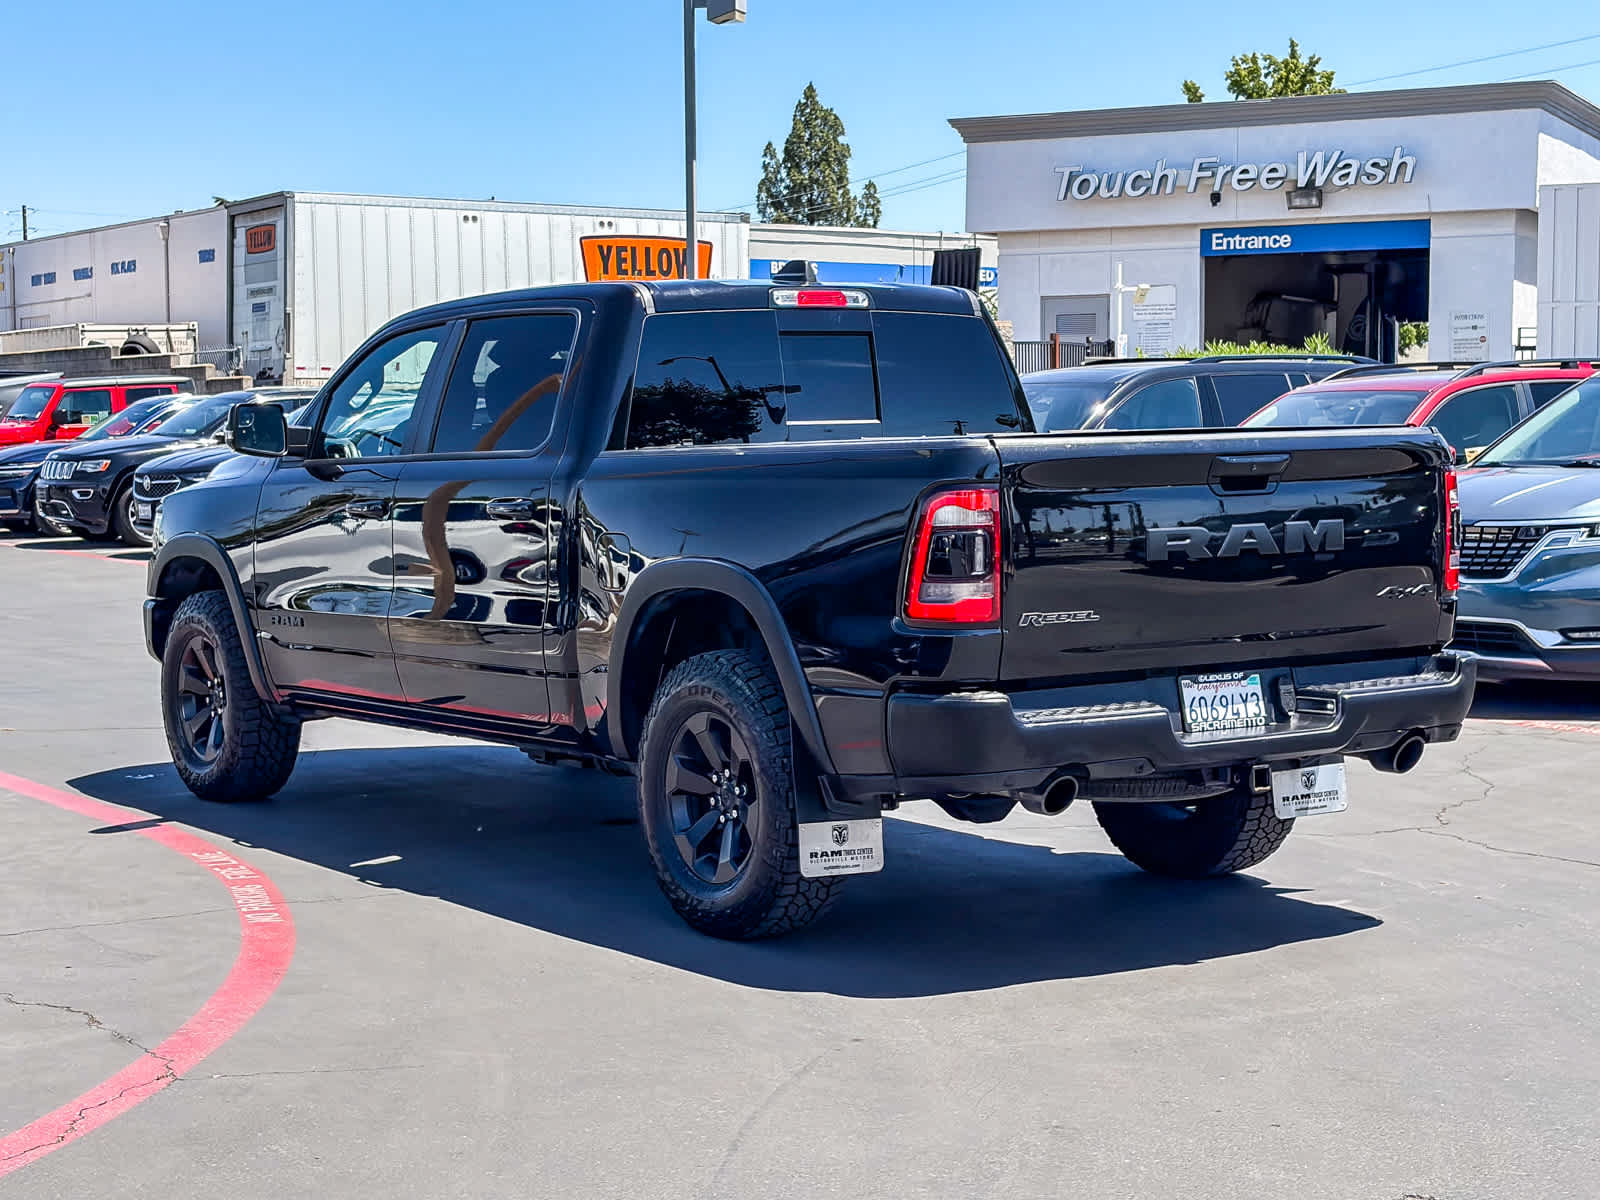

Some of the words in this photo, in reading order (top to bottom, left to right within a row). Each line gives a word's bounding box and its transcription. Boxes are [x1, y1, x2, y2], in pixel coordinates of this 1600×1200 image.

[1053, 159, 1177, 201] Touch
[1187, 155, 1287, 194] Free
[1296, 146, 1417, 189] Wash
[249, 230, 272, 249] YELLOW
[1211, 233, 1292, 251] Entrance
[1147, 519, 1344, 561] RAM
[272, 615, 304, 627] RAM
[1019, 610, 1100, 626] REBEL
[1204, 674, 1231, 682] LEXUS
[1233, 672, 1244, 680] OF
[1189, 692, 1262, 722] 60694Y3
[1191, 716, 1265, 733] SACRAMENTO
[1282, 793, 1311, 802] RAM
[809, 850, 842, 859] RAM
